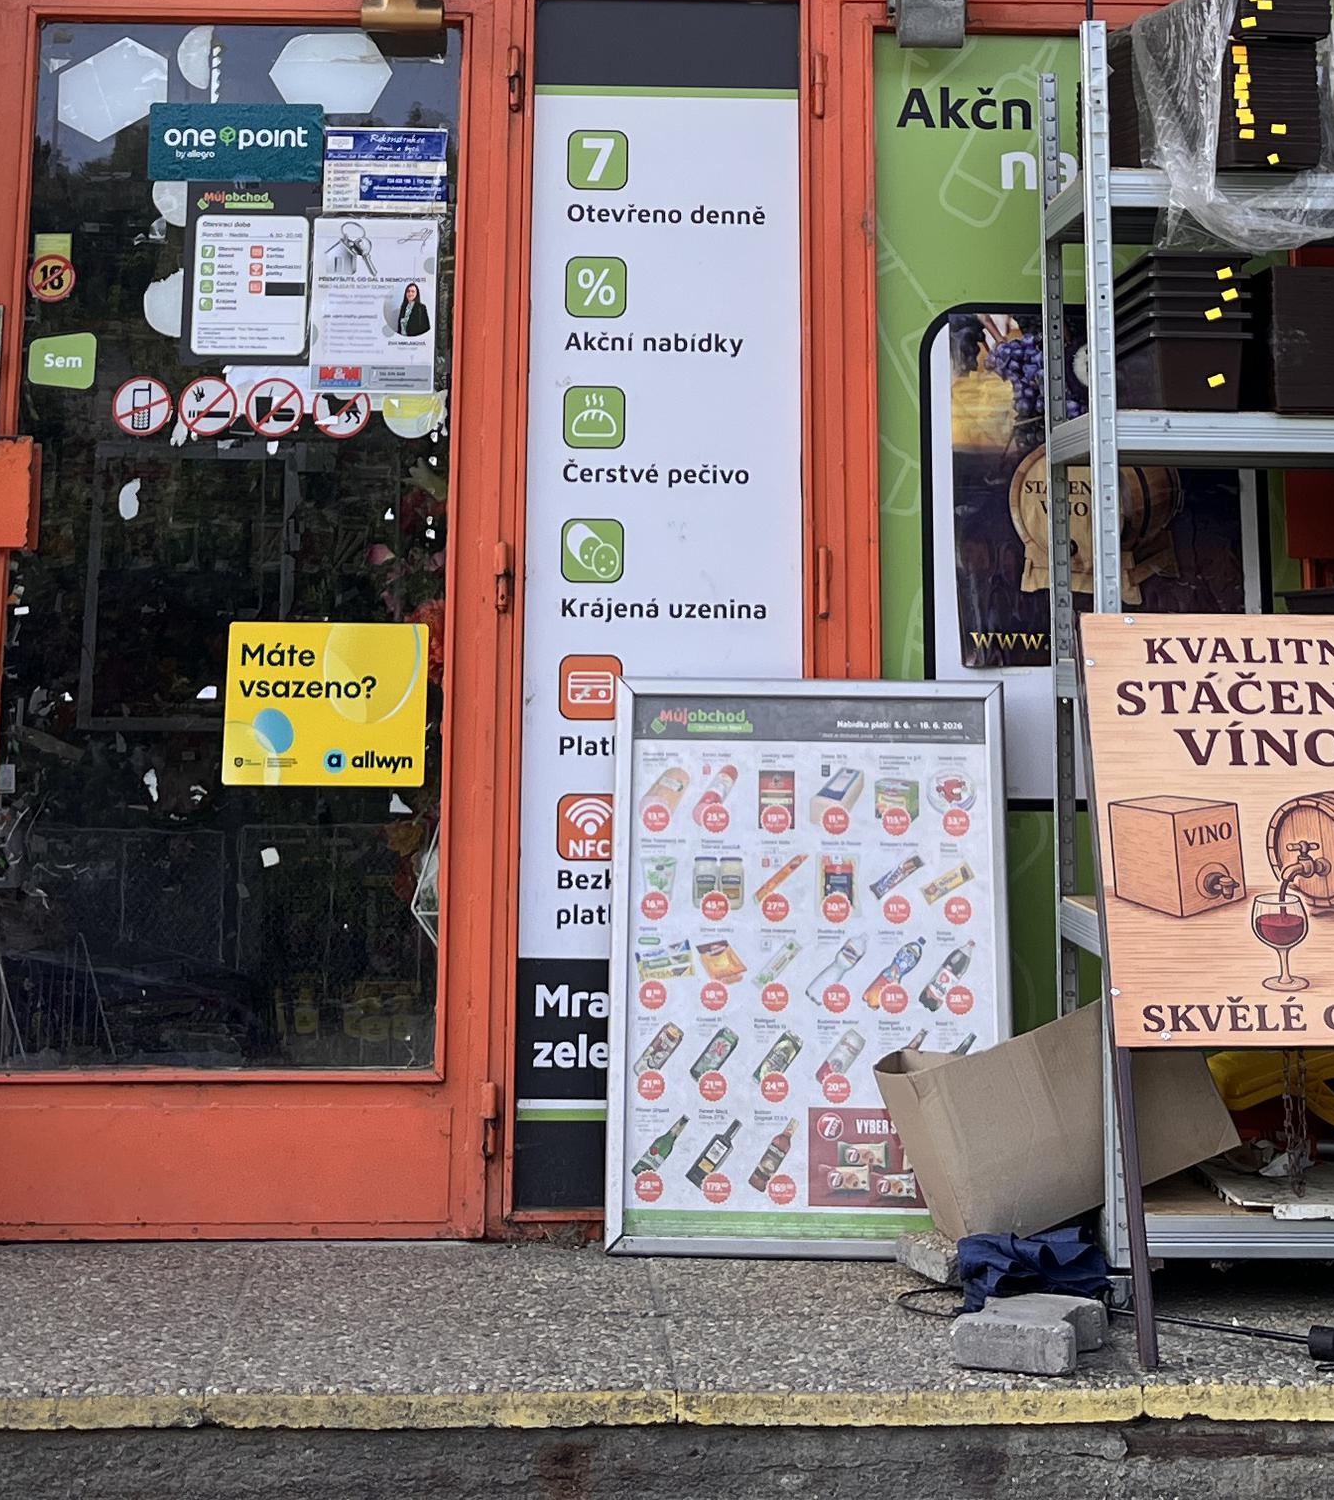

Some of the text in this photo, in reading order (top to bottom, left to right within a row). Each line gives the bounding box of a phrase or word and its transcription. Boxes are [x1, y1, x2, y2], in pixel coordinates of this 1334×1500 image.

[896, 87, 1031, 130] Akčn
[164, 126, 308, 150] one point
[175, 149, 215, 160] by allegro
[581, 138, 615, 182] 7
[566, 203, 766, 226] Otevřeno denně
[40, 265, 64, 290] 18
[565, 332, 744, 358] Akční nabídky
[44, 353, 82, 368] Sem
[562, 458, 750, 488] Čerstvé pečivo
[560, 598, 768, 624] Krájená uzenina
[240, 643, 316, 667] Máte
[239, 675, 377, 699] vsazeno?
[837, 720, 869, 729] Nabídka
[559, 735, 615, 756] Plat
[351, 750, 413, 774] allwyn
[1183, 821, 1233, 847] VINO
[568, 839, 611, 858] NFC
[556, 904, 611, 930] plat
[535, 984, 609, 1018] Mra
[1142, 996, 1308, 1033] SKVĚLÉ
[533, 1033, 609, 1069] zele
[856, 1119, 888, 1134] VYBER
